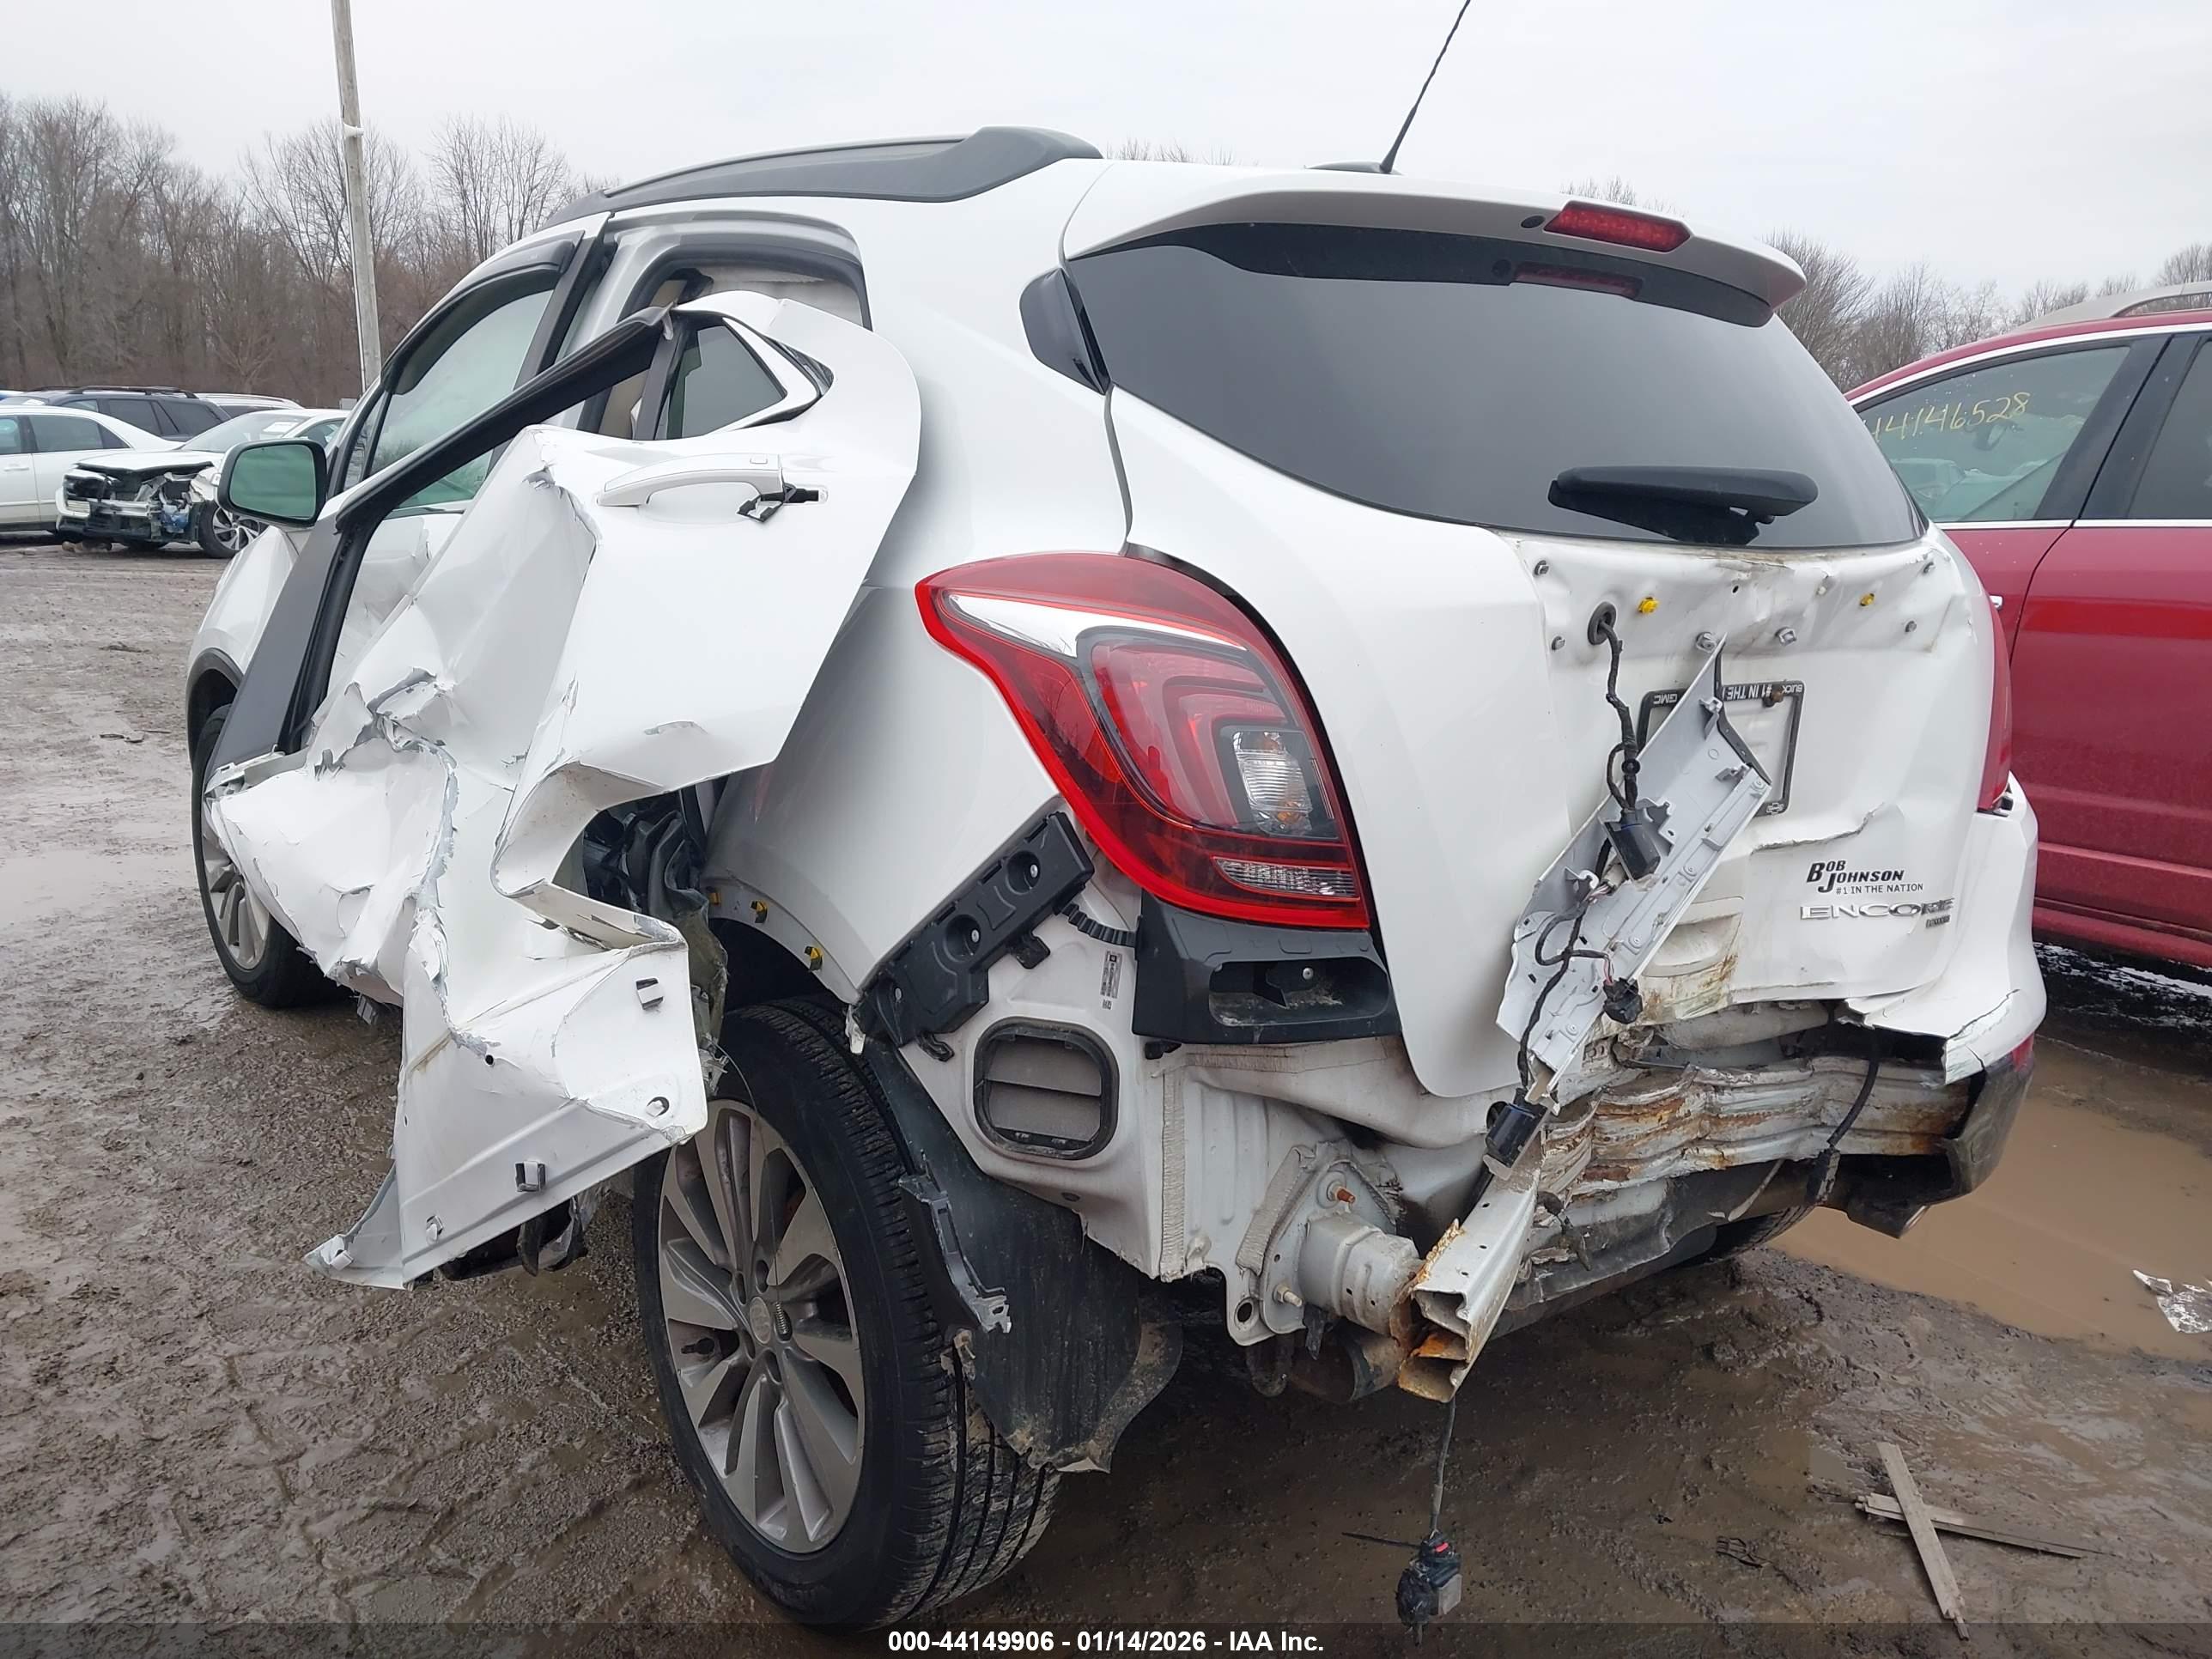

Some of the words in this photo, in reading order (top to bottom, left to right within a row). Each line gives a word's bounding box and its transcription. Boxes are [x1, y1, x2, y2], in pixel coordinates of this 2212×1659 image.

[1727, 686, 1747, 701] THE
[1748, 684, 1759, 698] IN
[1653, 693, 1678, 704] GMC
[1807, 860, 1845, 883] BOB
[1818, 870, 1904, 893] JOHNSON
[1836, 886, 1848, 895] #1
[1850, 885, 1862, 895] IN
[1866, 884, 1883, 894] THE
[1886, 883, 1923, 892] NATION
